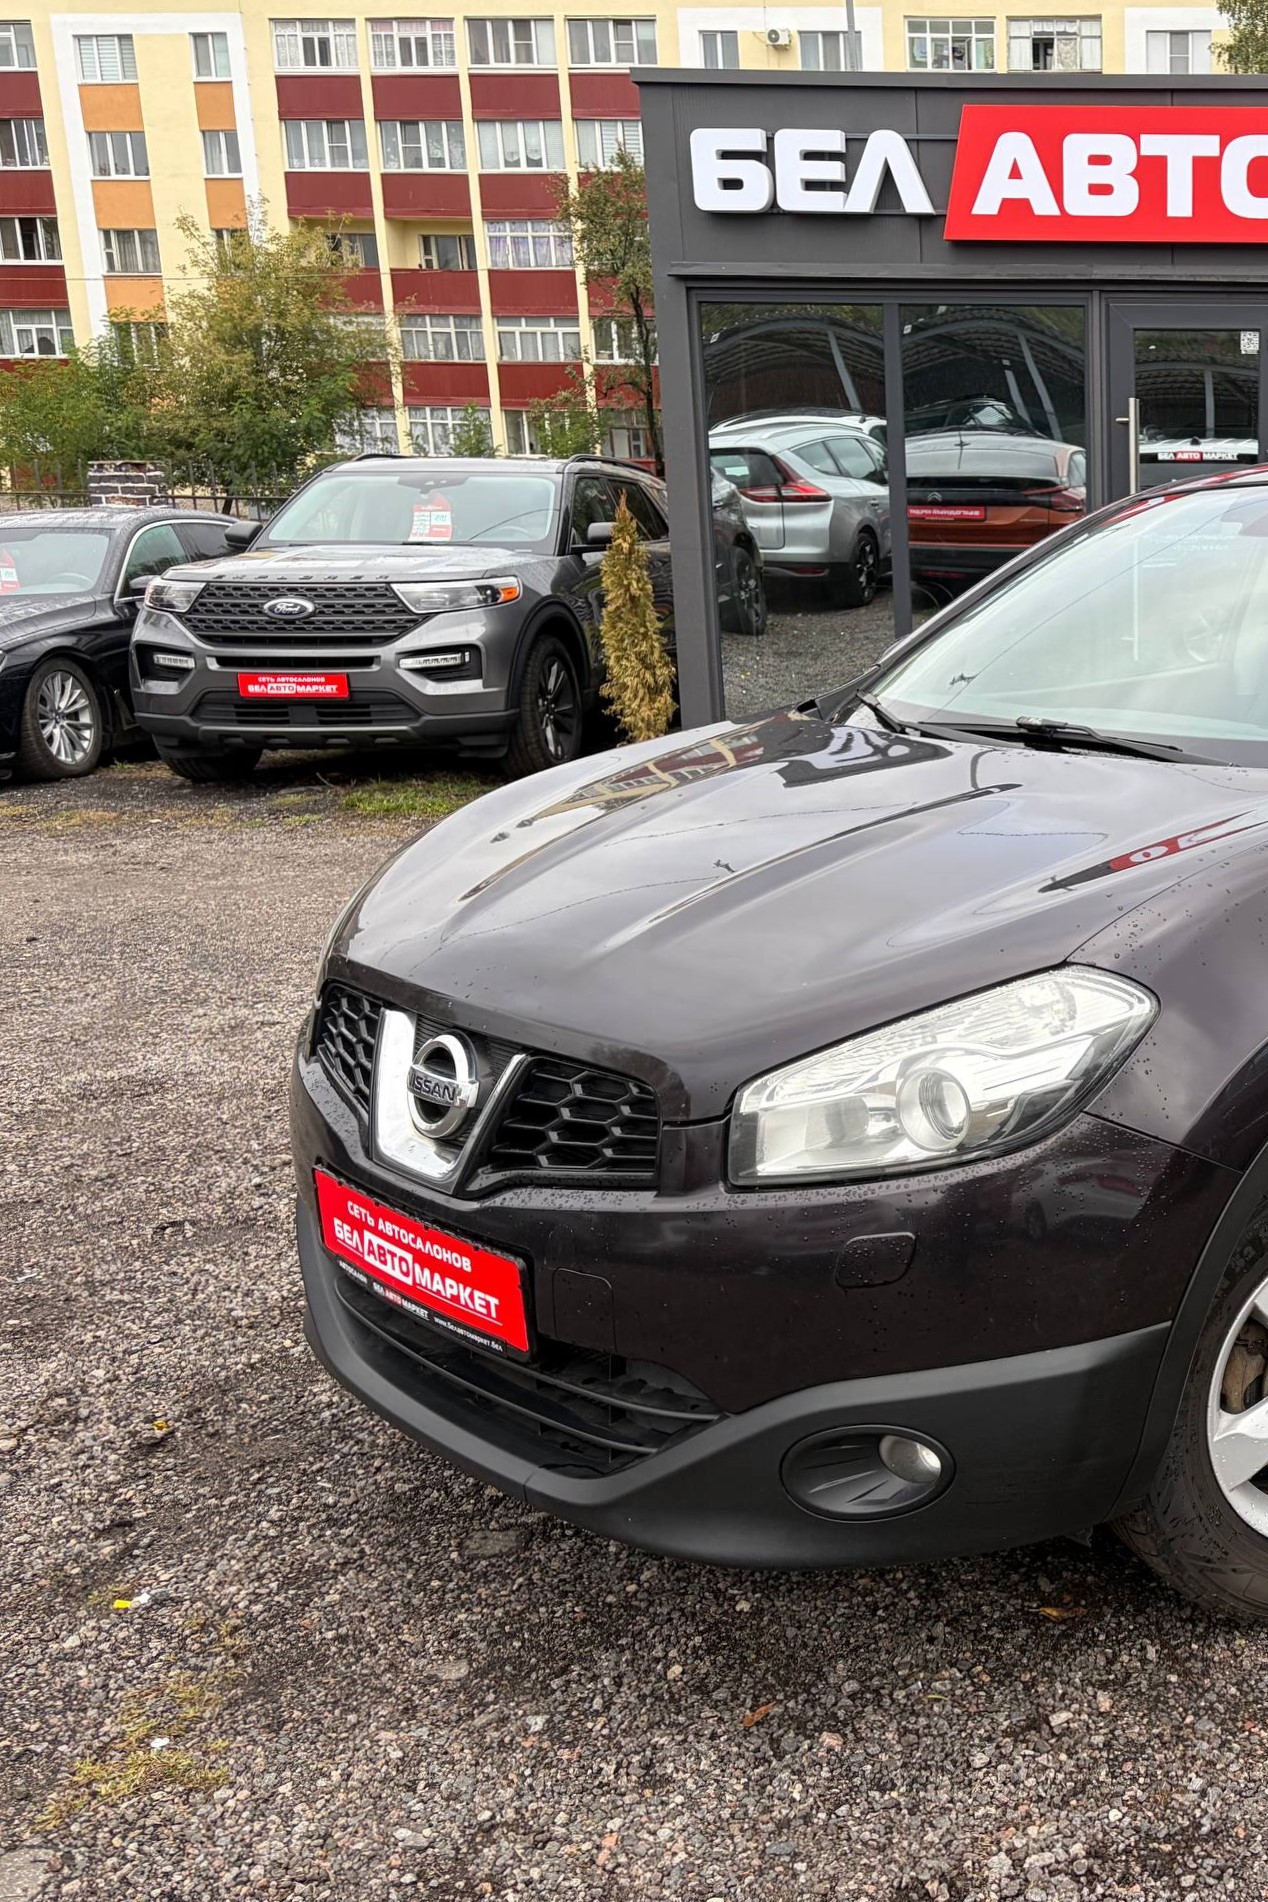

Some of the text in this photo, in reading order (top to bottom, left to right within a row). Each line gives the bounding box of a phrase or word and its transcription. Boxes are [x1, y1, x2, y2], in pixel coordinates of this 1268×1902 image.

[689, 127, 936, 215] БЕЛ
[1176, 452, 1200, 460] АВТО
[1202, 452, 1239, 460] МАРКЕТ
[273, 602, 300, 615] Ford
[268, 684, 295, 693] АВТО
[296, 684, 338, 693] МАРКЕТ
[409, 1071, 456, 1102] ISSAN
[347, 1200, 472, 1273] СЕТЬ АВТОСАЛОНОВ
[333, 1217, 500, 1319] БЕЛ АВТО МАРКЕТ
[385, 1289, 402, 1306] АВТО
[401, 1298, 429, 1319] МАРКЕТ
